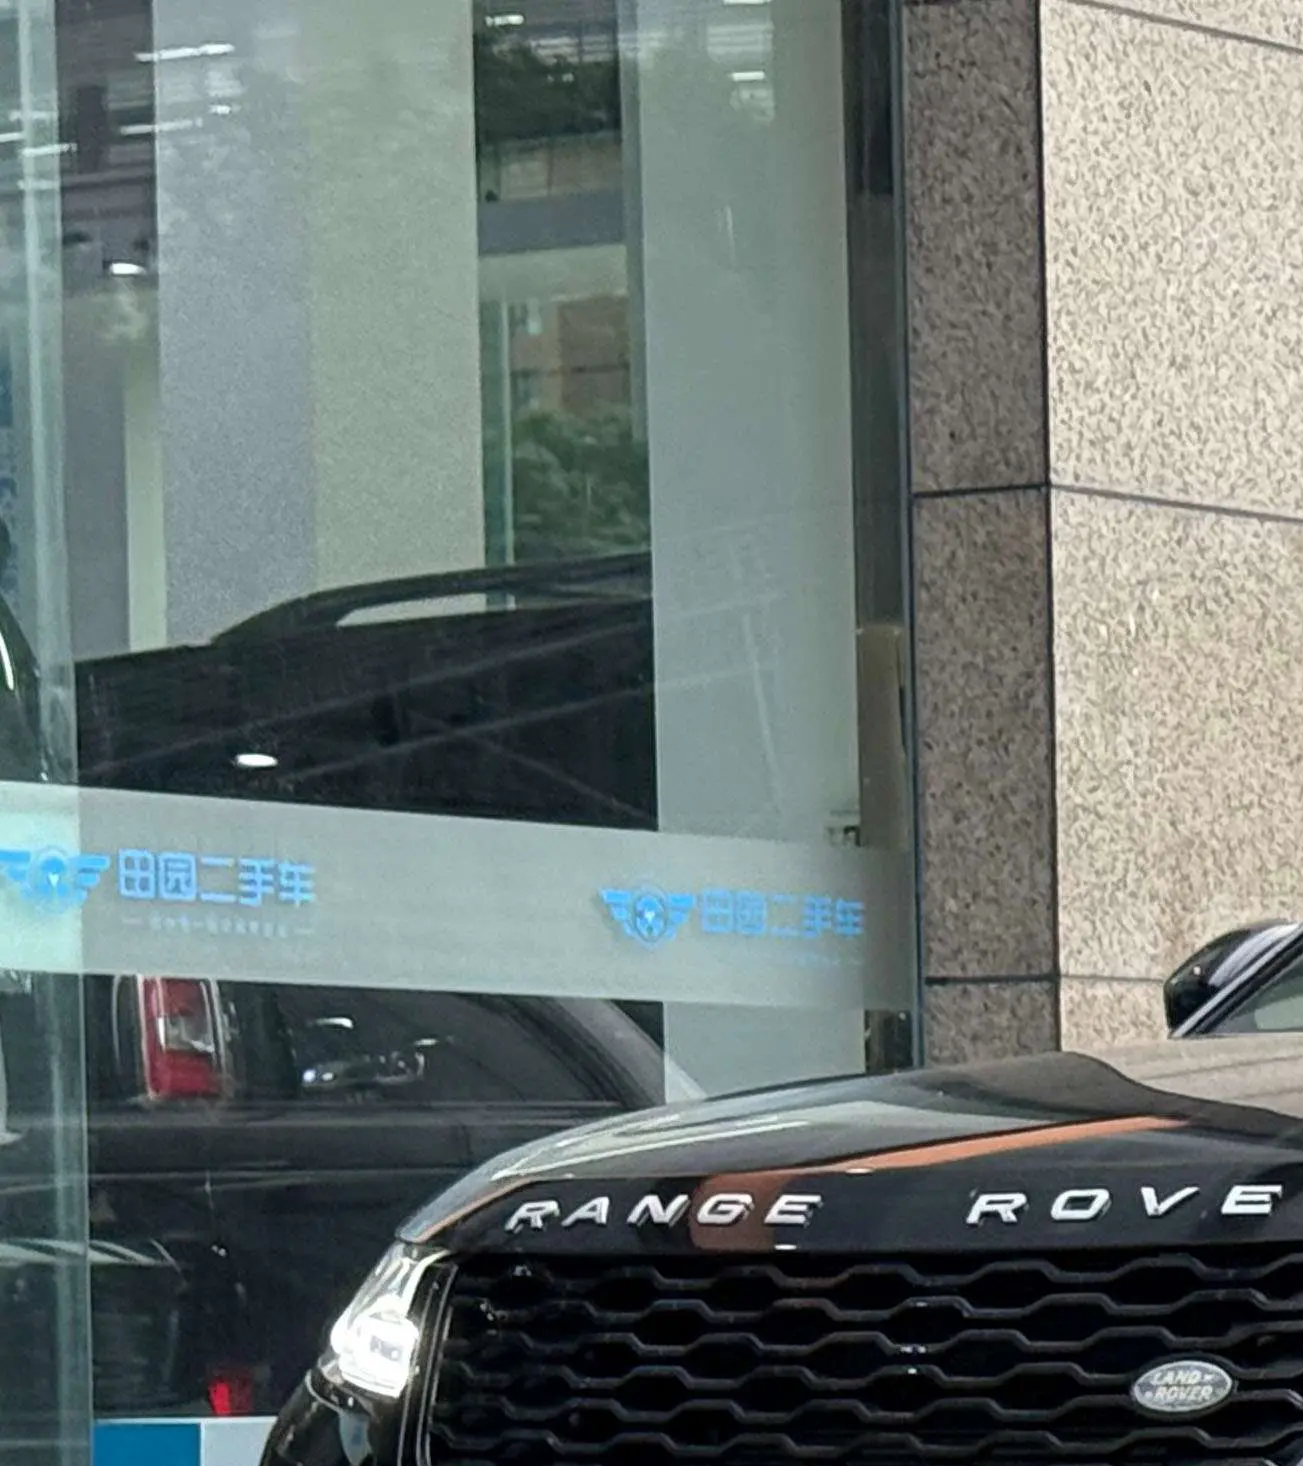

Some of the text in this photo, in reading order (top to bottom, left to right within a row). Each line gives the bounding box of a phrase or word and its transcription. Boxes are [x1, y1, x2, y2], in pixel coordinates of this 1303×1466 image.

[118, 848, 317, 907] 田园二手车
[701, 887, 864, 940] 田园二手车
[504, 1193, 824, 1234] RANGE
[1150, 1369, 1202, 1386] LAND
[1154, 1385, 1214, 1402] ROVER
